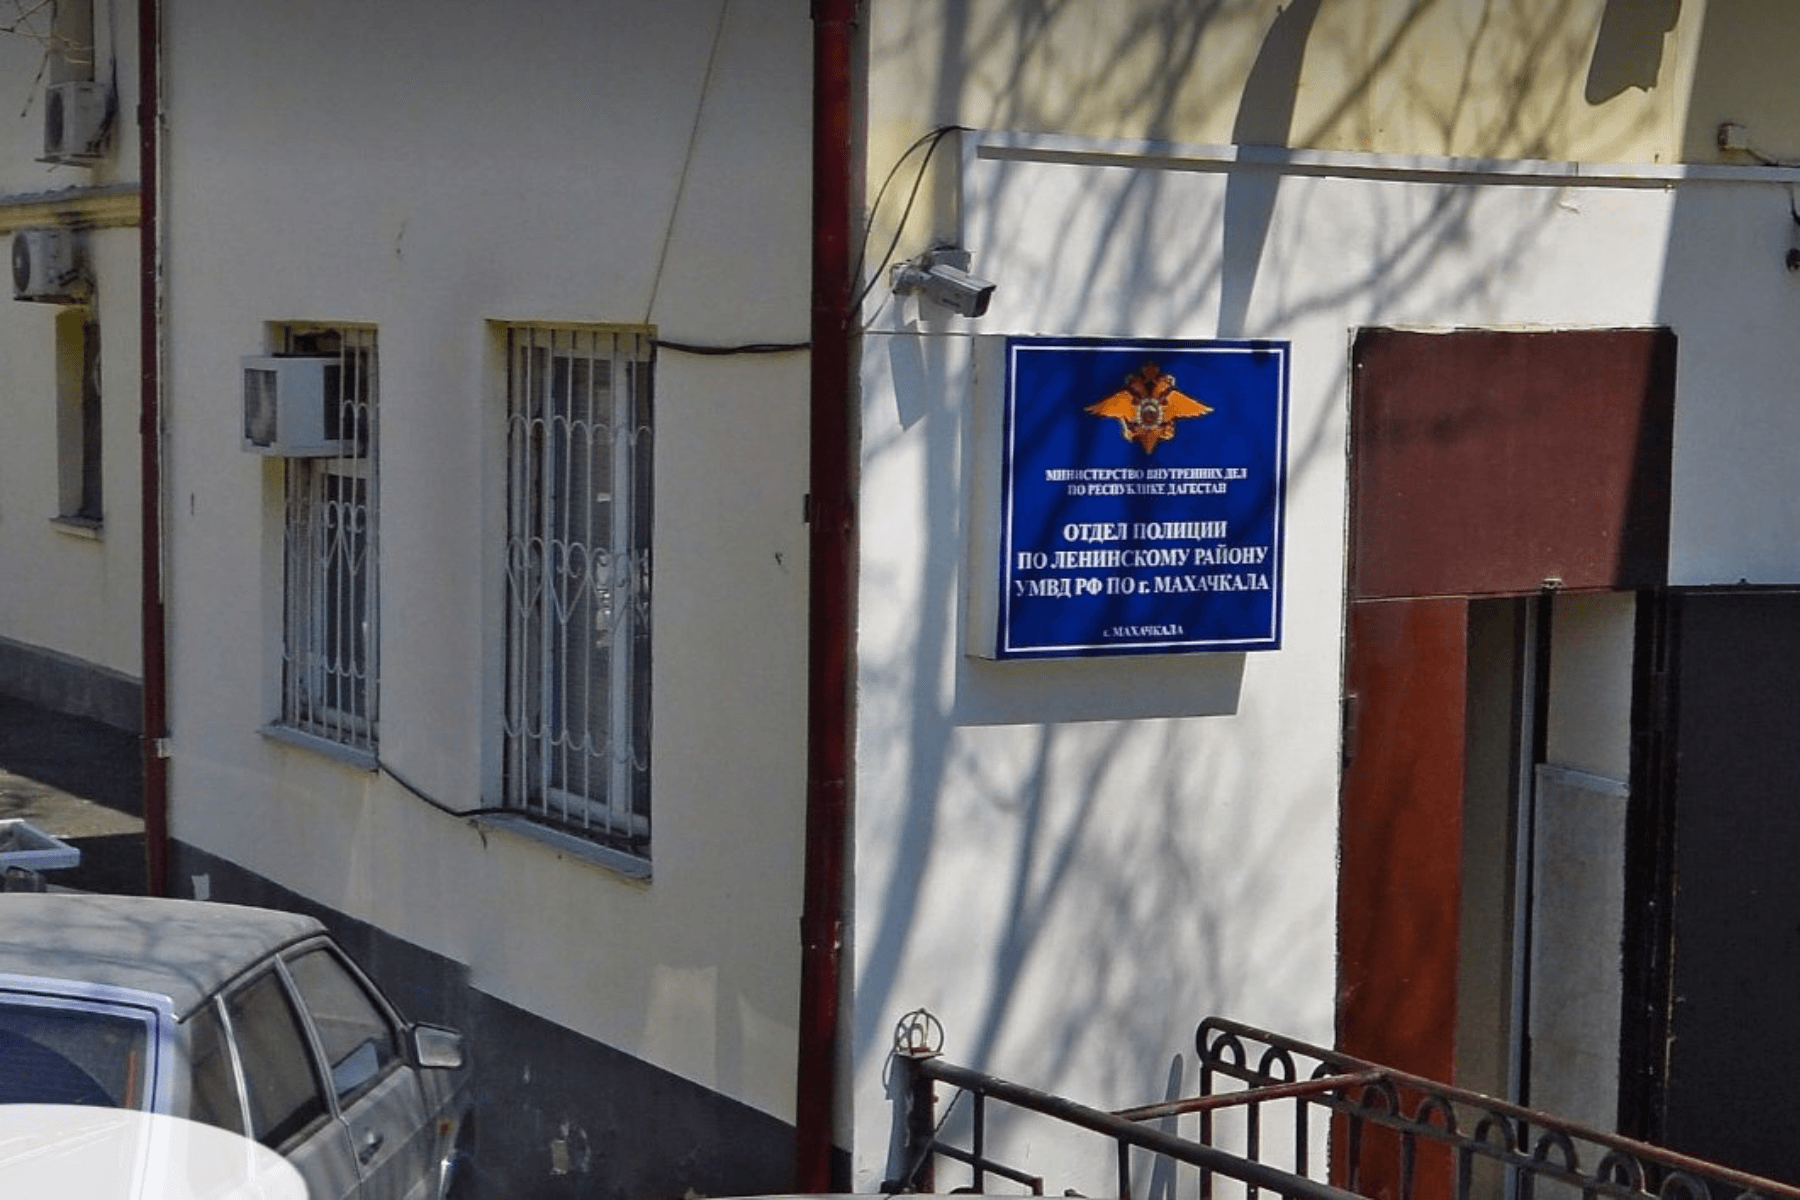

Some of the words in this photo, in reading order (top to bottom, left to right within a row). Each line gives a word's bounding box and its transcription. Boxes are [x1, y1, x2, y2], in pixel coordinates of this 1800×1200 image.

[1045, 468, 1144, 481] МИНИСТЕРСТВО
[1147, 468, 1223, 480] ВНУТРЕННИХ
[1224, 468, 1247, 480] ДЕЛ
[1068, 484, 1086, 496] ПО
[1088, 484, 1165, 495] РЕСПУБЛИКЕ
[1167, 483, 1227, 495] ДАГЕСТАН
[1063, 522, 1127, 544] ОТДЕЛ
[1133, 520, 1227, 542] ПОЛИЦИИ
[1017, 552, 1048, 570] ПО
[1050, 548, 1190, 569] ЛЕНИНСКОМУ
[1194, 544, 1269, 566] РАЙОНУ
[1015, 578, 1072, 599] УМВД
[1074, 577, 1103, 596] РФ
[1106, 577, 1135, 595] ПО
[1137, 580, 1150, 595] г.
[1154, 573, 1269, 594] МАХАЧКАЛА
[1112, 624, 1184, 638] МАХАЧКАЛА
